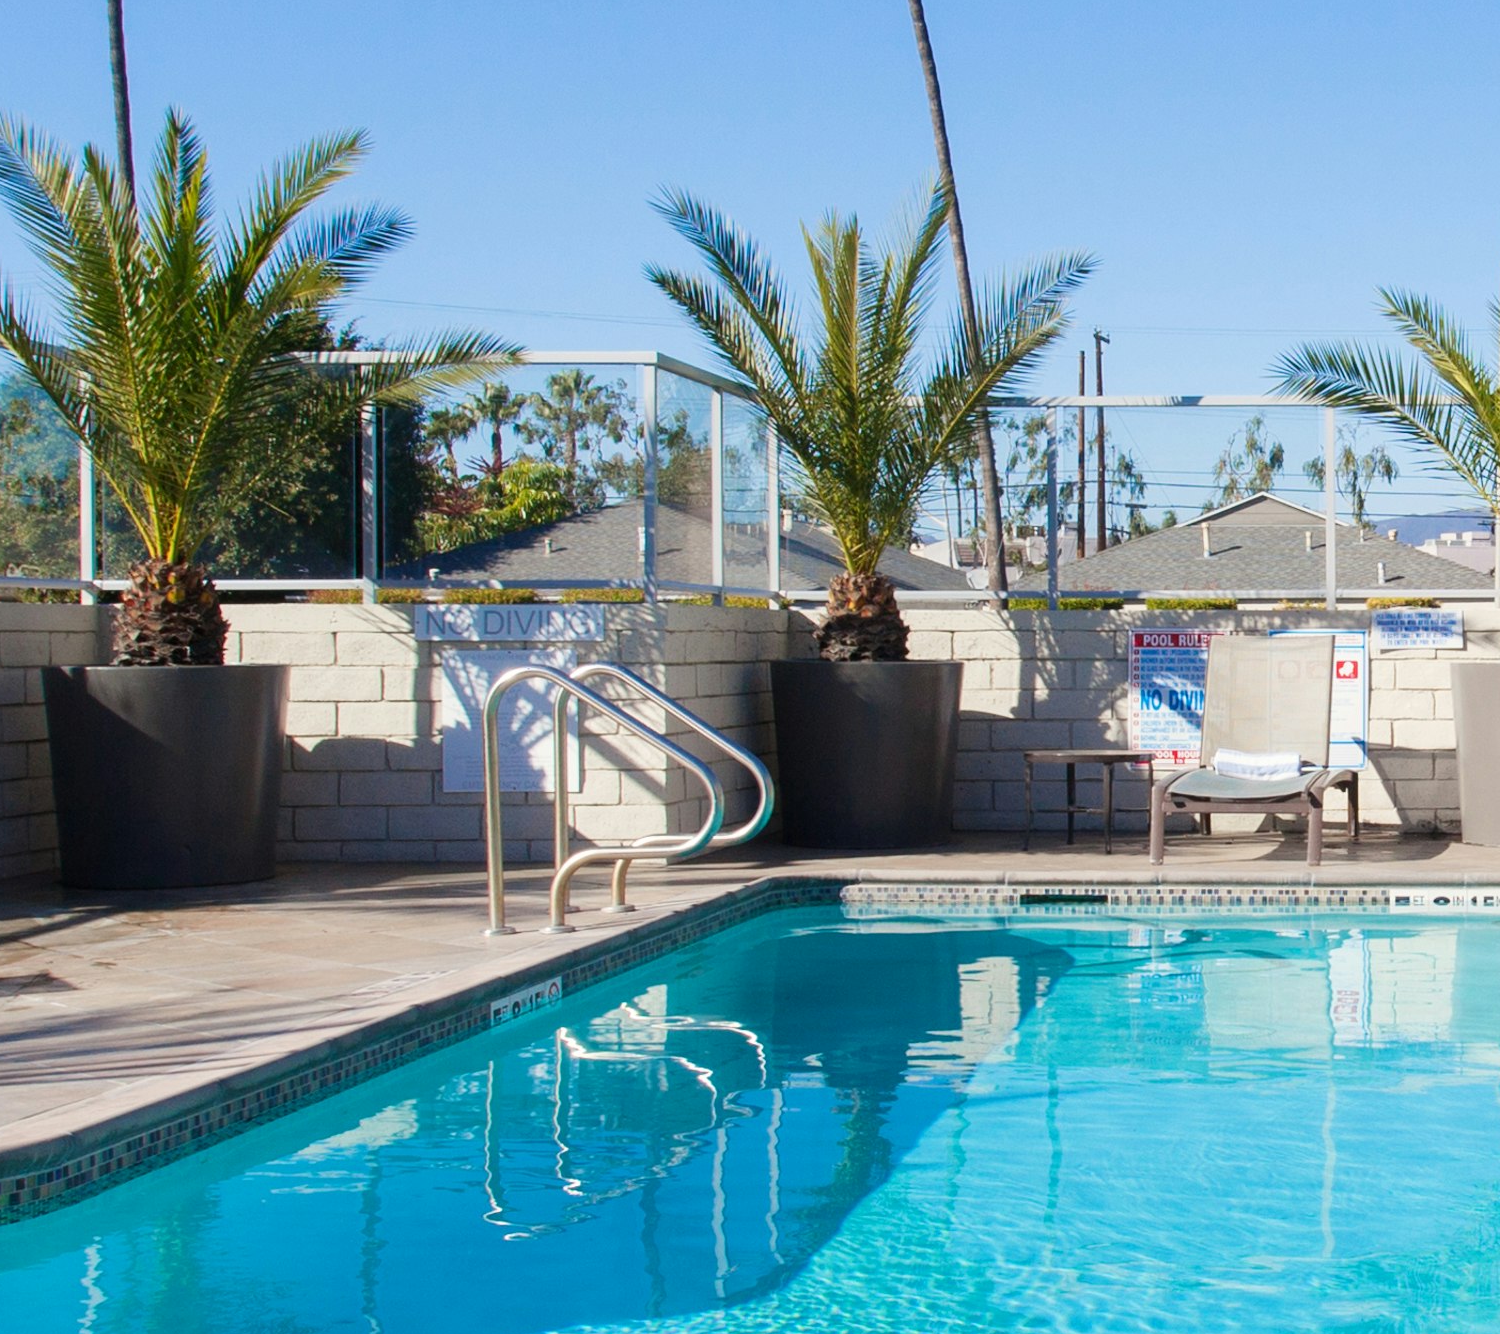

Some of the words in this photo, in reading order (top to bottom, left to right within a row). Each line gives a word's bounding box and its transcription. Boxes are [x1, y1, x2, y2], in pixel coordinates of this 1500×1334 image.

[426, 610, 473, 636] NO
[483, 610, 591, 636] DIVING
[1143, 634, 1174, 646] POOL
[1179, 634, 1208, 647] RULE
[1140, 689, 1162, 710] NO
[1168, 689, 1204, 710] DIVIN
